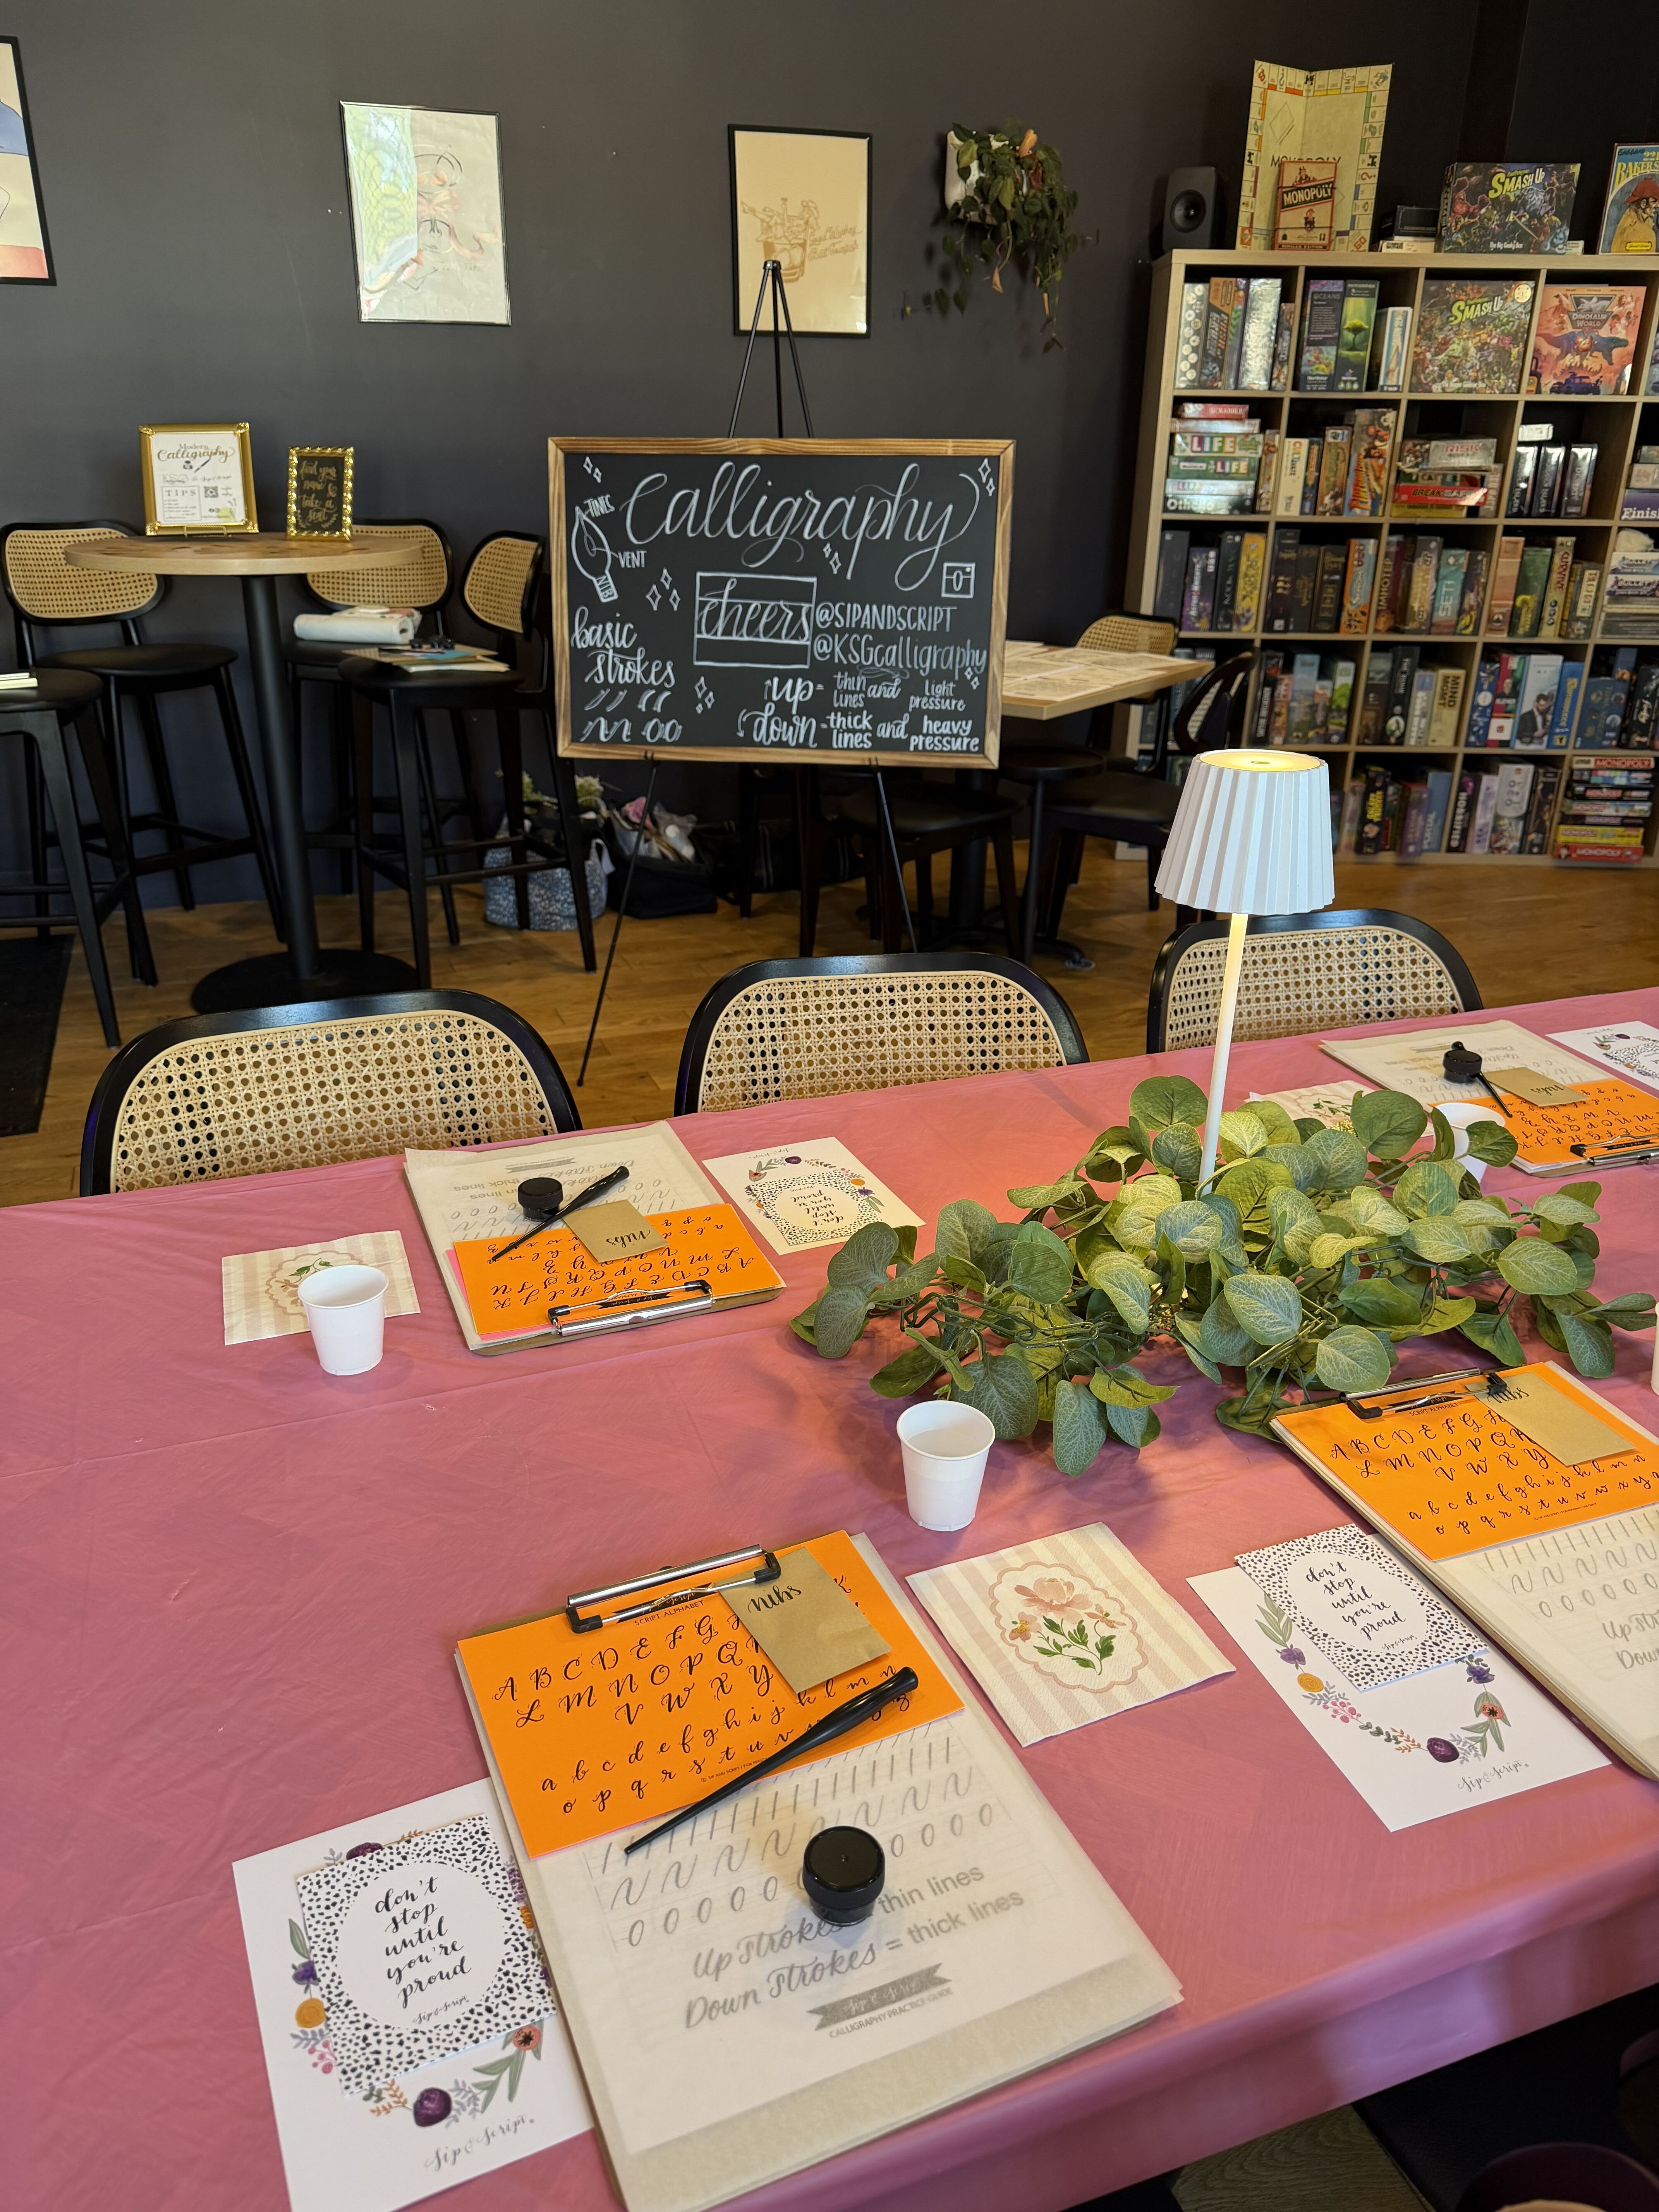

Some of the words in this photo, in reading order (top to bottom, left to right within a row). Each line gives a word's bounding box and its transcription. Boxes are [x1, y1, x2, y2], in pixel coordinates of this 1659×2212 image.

[1283, 182, 1333, 206] MONOPOLY
[1488, 172, 1533, 199] SMASH
[1535, 168, 1545, 184] UP
[1449, 299, 1493, 326] SMASH
[157, 446, 235, 463] Calligraphy
[1190, 435, 1235, 453] LIFE
[1445, 443, 1481, 453] RISK
[1216, 459, 1248, 474] LIFE
[583, 494, 615, 518] TINES
[621, 462, 980, 591] Calligraphy
[618, 551, 646, 568] VENT
[596, 575, 614, 599] NIB
[1377, 558, 1393, 610] IMHOTEP
[698, 578, 812, 641] cheers
[815, 602, 958, 632] @SIPANDSCRIPT
[571, 606, 637, 649] basic
[585, 648, 676, 688] strokes
[814, 634, 987, 680] @KSGcalligraphy
[833, 672, 867, 691] thin
[867, 677, 901, 699] and
[924, 678, 956, 697] light
[1437, 675, 1450, 708] MGMT
[1447, 675, 1461, 708] MIND
[771, 676, 814, 714] up
[833, 690, 865, 709] lines
[909, 695, 965, 713] pressure
[749, 703, 818, 749] down
[826, 711, 873, 730] thick
[877, 714, 910, 740] and
[922, 714, 972, 736] heavy
[832, 730, 872, 749] lines
[910, 734, 980, 752] pressure
[1595, 759, 1652, 768] MONOPOLY
[1576, 848, 1621, 857] MONOPOLY
[453, 1182, 485, 1192] lines
[470, 1190, 503, 1200] lines
[489, 1178, 520, 1191] thick
[790, 1190, 825, 1202] proud
[804, 1204, 835, 1214] until
[812, 1210, 837, 1218] stop
[813, 1215, 844, 1226] don't
[606, 1229, 651, 1249] nibs
[1409, 1408, 1429, 1417] SCRIPT
[1430, 1402, 1459, 1412] ALPHABET
[1305, 1561, 1347, 1582] don't
[1323, 1577, 1355, 1595] stop
[1331, 1585, 1372, 1609] until
[747, 1584, 803, 1614] nibs
[634, 1613, 661, 1626] SCRIPT
[664, 1600, 705, 1618] ALPHABET
[1341, 1601, 1391, 1626] you're
[1360, 1610, 1406, 1641] proud
[1602, 1620, 1632, 1642] Up
[1616, 1649, 1659, 1670] Dow
[374, 1875, 439, 1914] don't
[385, 1903, 439, 1933] stop
[693, 1949, 733, 1983] Up
[878, 1886, 925, 1915] thin
[927, 1865, 985, 1897] lines
[385, 1915, 449, 1957] until
[386, 1941, 465, 1982] you're
[684, 1989, 762, 2029] Down
[766, 1942, 877, 1999] Strokes
[907, 1909, 967, 1945] thick
[969, 1889, 1026, 1922] lines
[397, 1955, 473, 2009] proud
[828, 2011, 888, 2039] CALLIGRAPHY
[887, 1999, 926, 2019] PRACTICE
[927, 1987, 954, 2002] GUIDE
